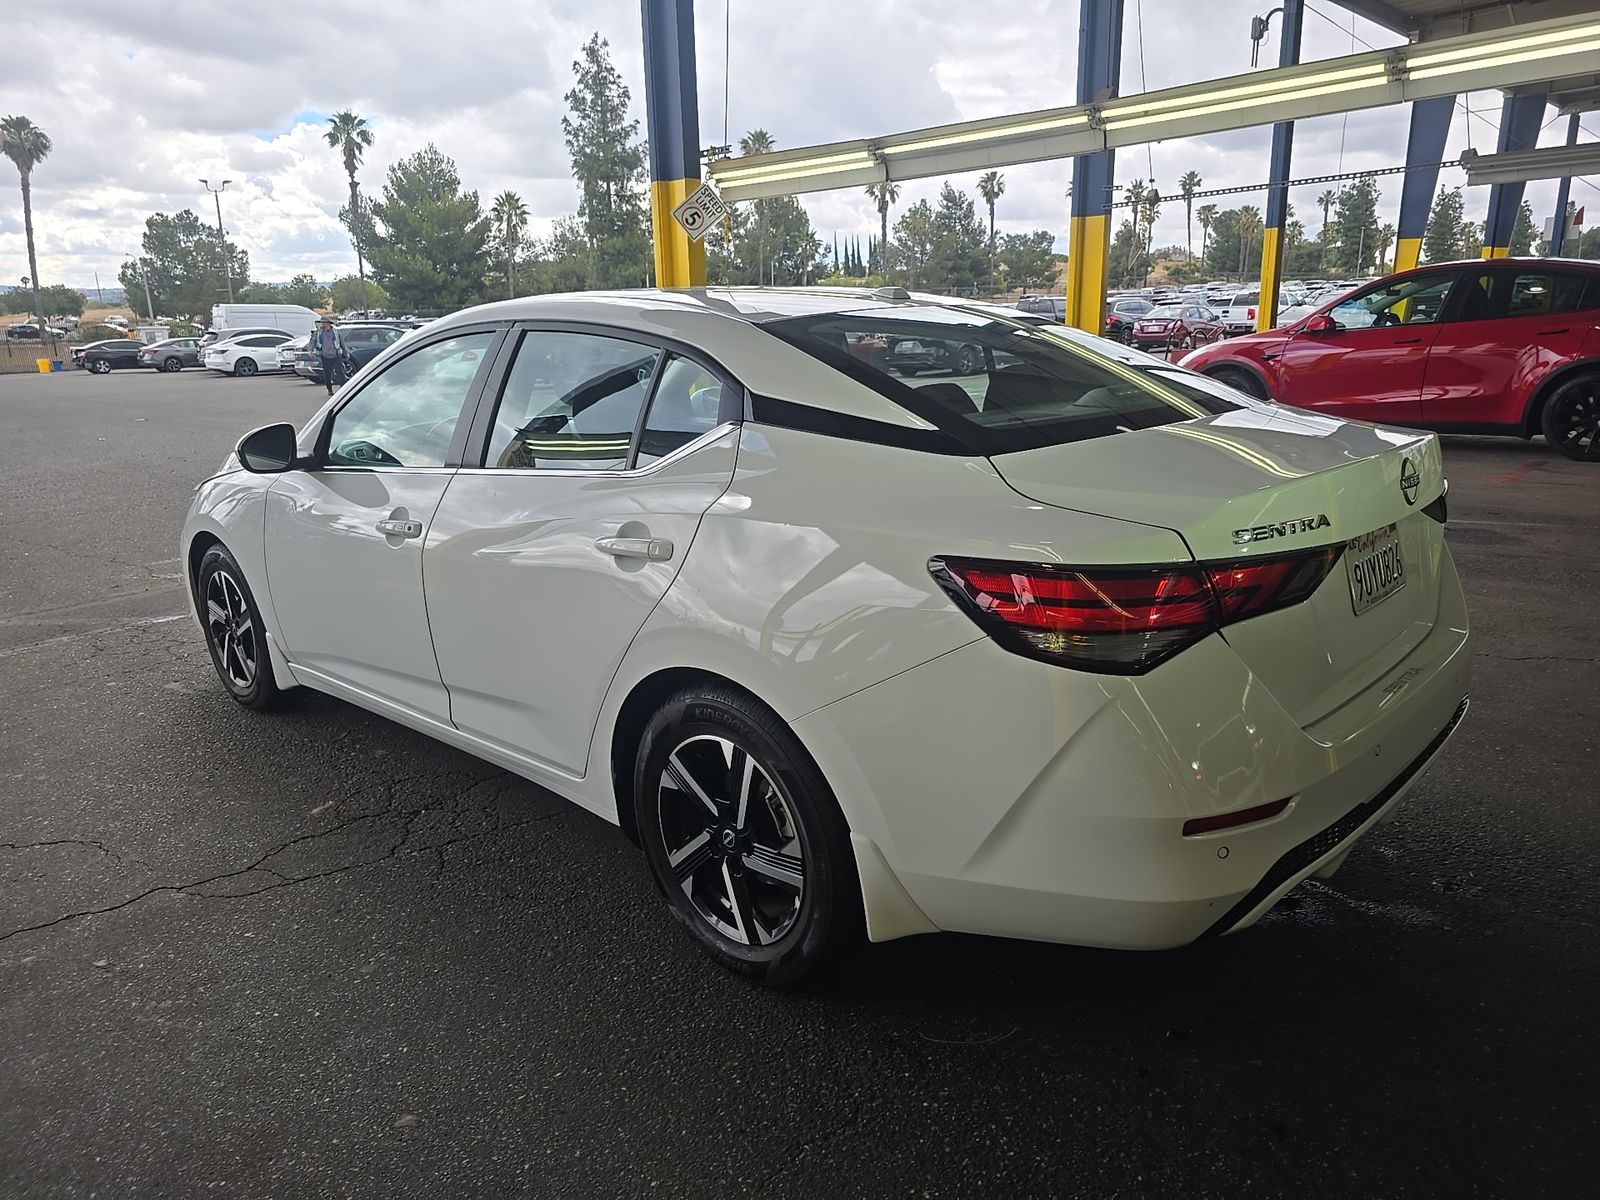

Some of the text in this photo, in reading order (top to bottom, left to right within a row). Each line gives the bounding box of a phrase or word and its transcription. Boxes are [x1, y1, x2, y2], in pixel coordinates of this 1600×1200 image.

[696, 195, 716, 219] LIMIT
[701, 188, 723, 214] SPEED
[685, 211, 701, 226] 5
[1231, 514, 1331, 545] SENTRA
[1353, 540, 1403, 602] 9UYU826
